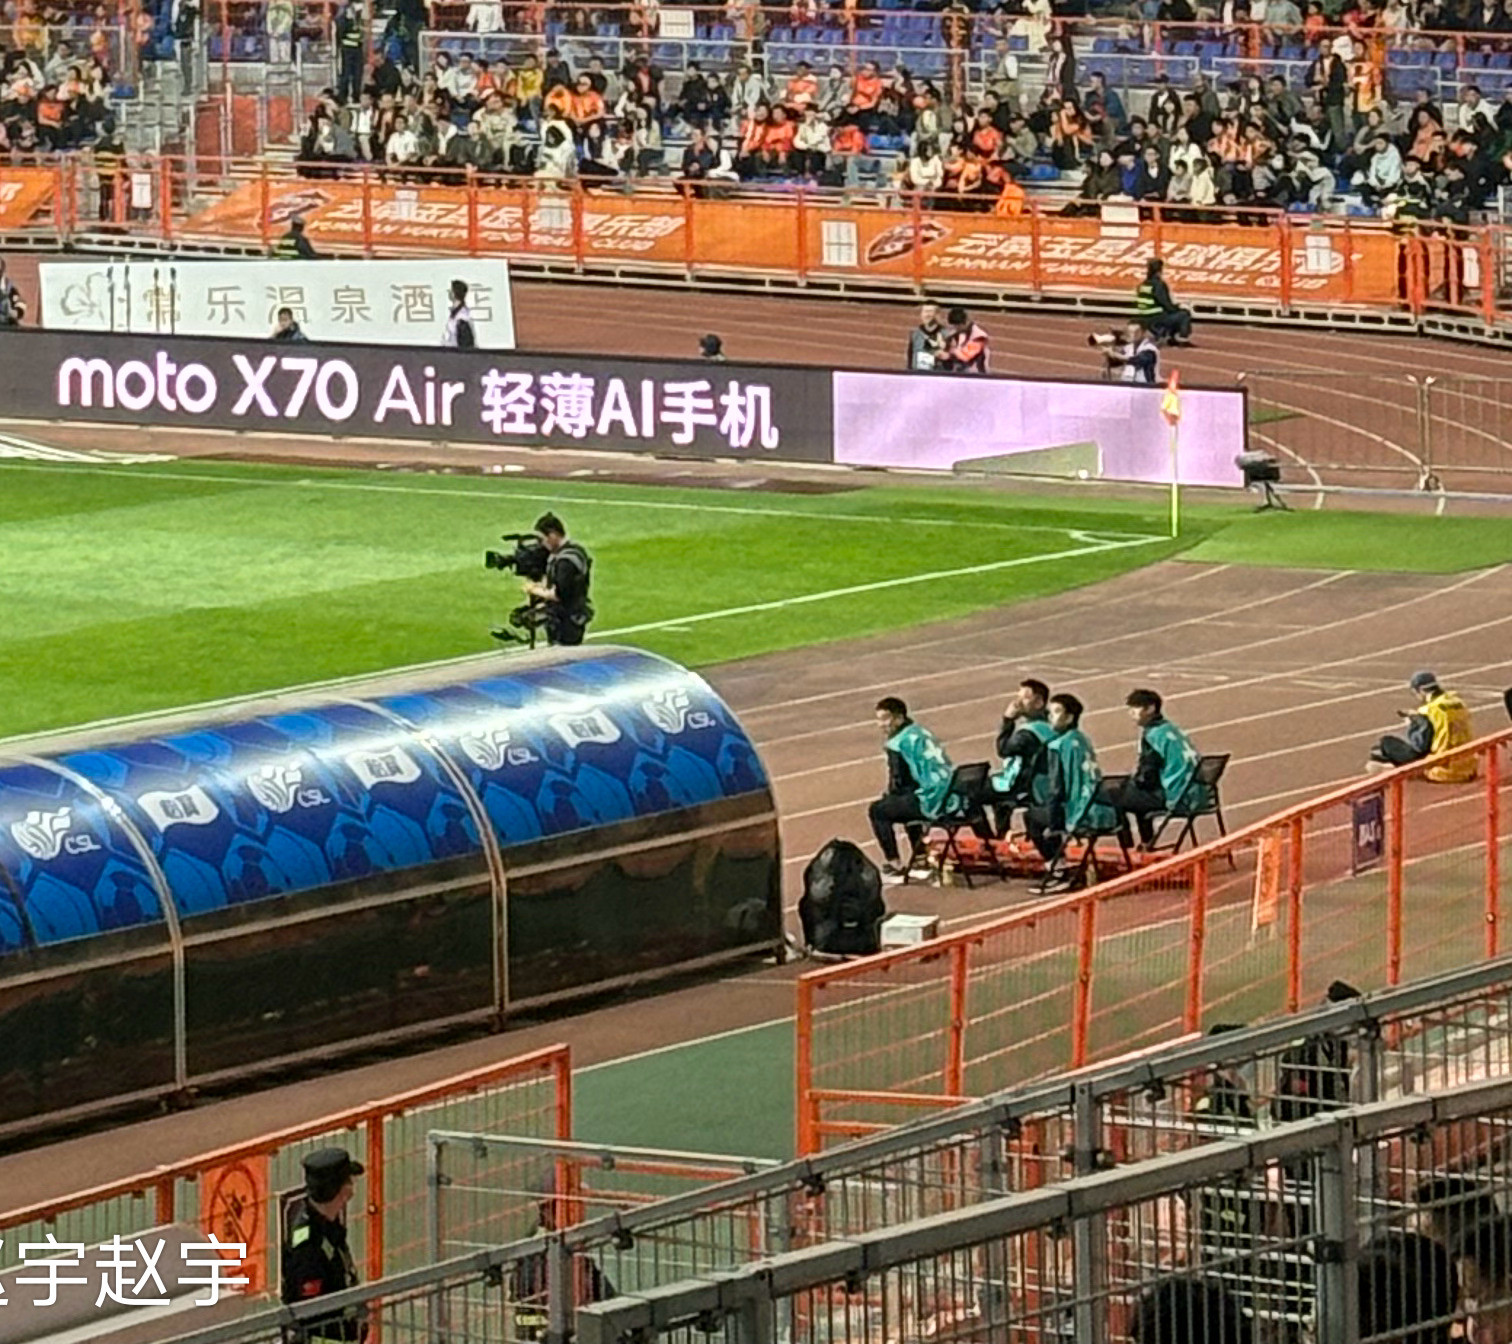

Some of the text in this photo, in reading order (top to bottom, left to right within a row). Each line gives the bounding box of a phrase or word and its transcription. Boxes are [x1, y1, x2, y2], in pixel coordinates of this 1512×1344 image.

[57, 351, 780, 450] moto X70 Air 轻薄AI手机
[297, 787, 331, 808] CSL
[64, 833, 102, 855] CSL
